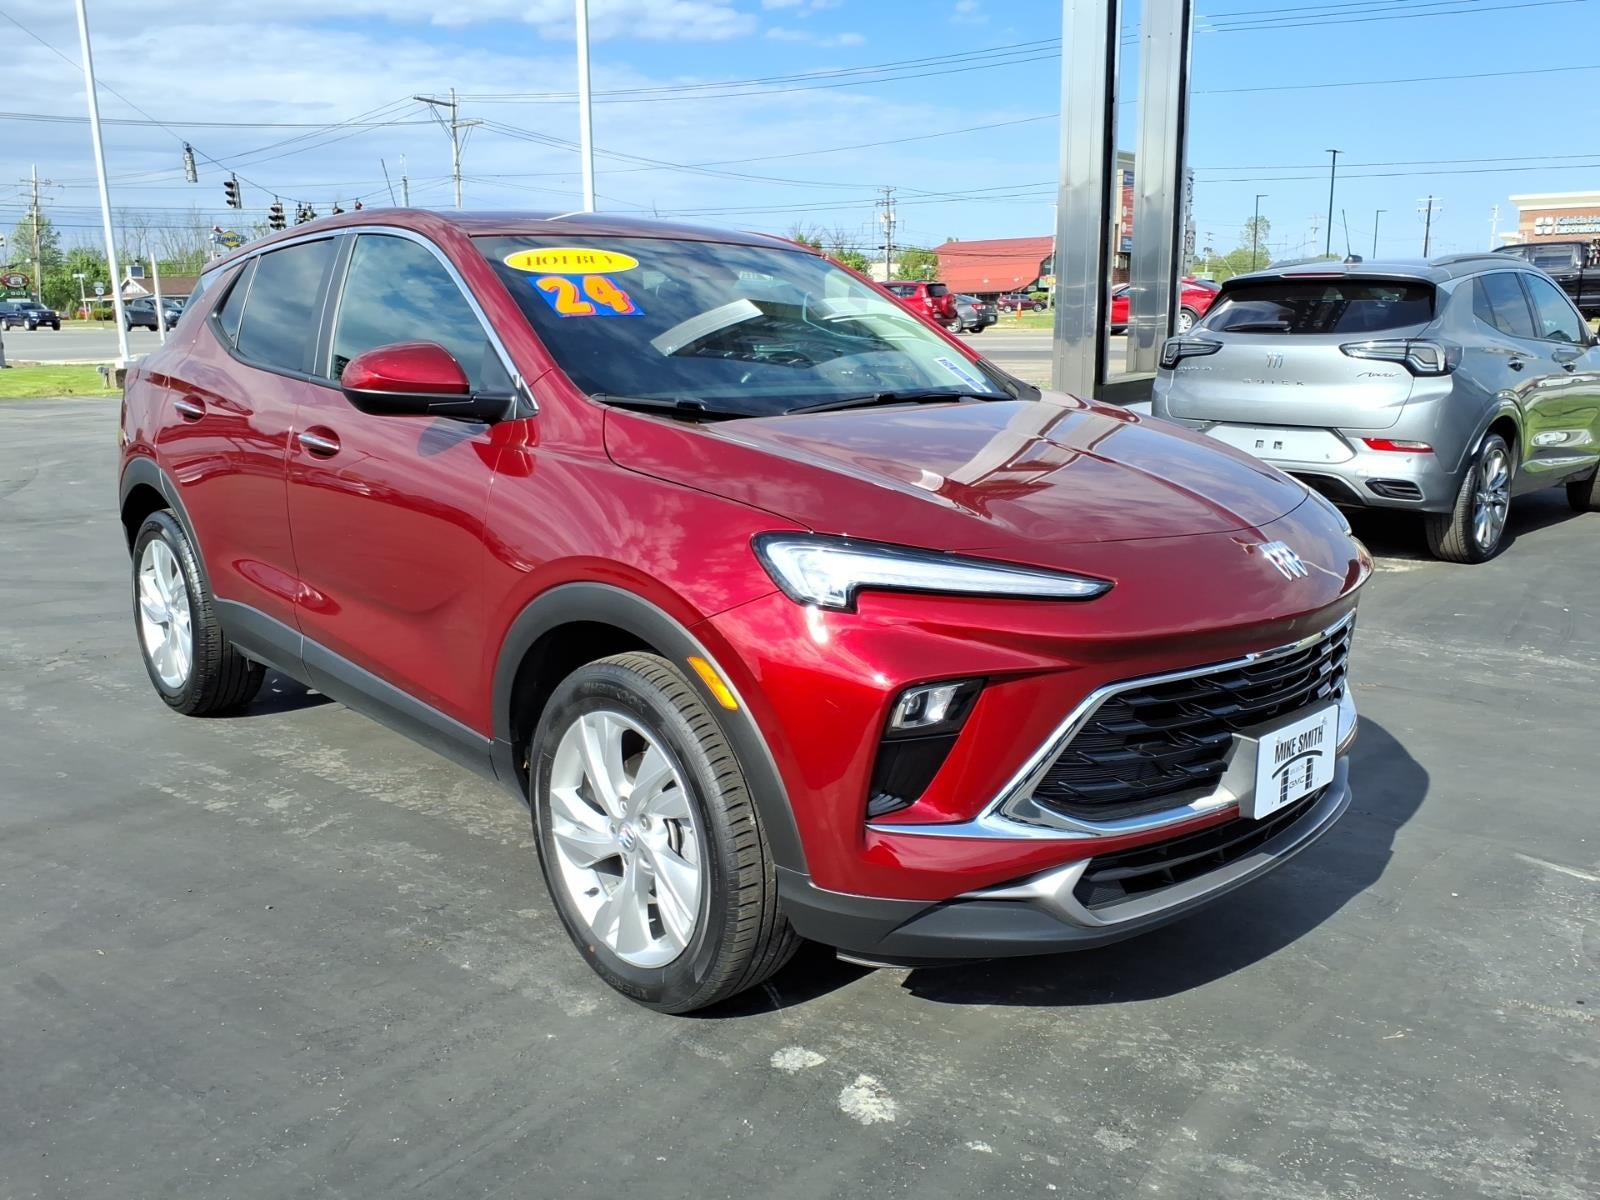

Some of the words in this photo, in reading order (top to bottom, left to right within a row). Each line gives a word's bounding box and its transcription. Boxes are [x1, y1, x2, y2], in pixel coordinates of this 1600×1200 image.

[535, 275, 635, 315] 24
[1274, 737, 1297, 764] MIKE
[1298, 725, 1324, 753] SMITH
